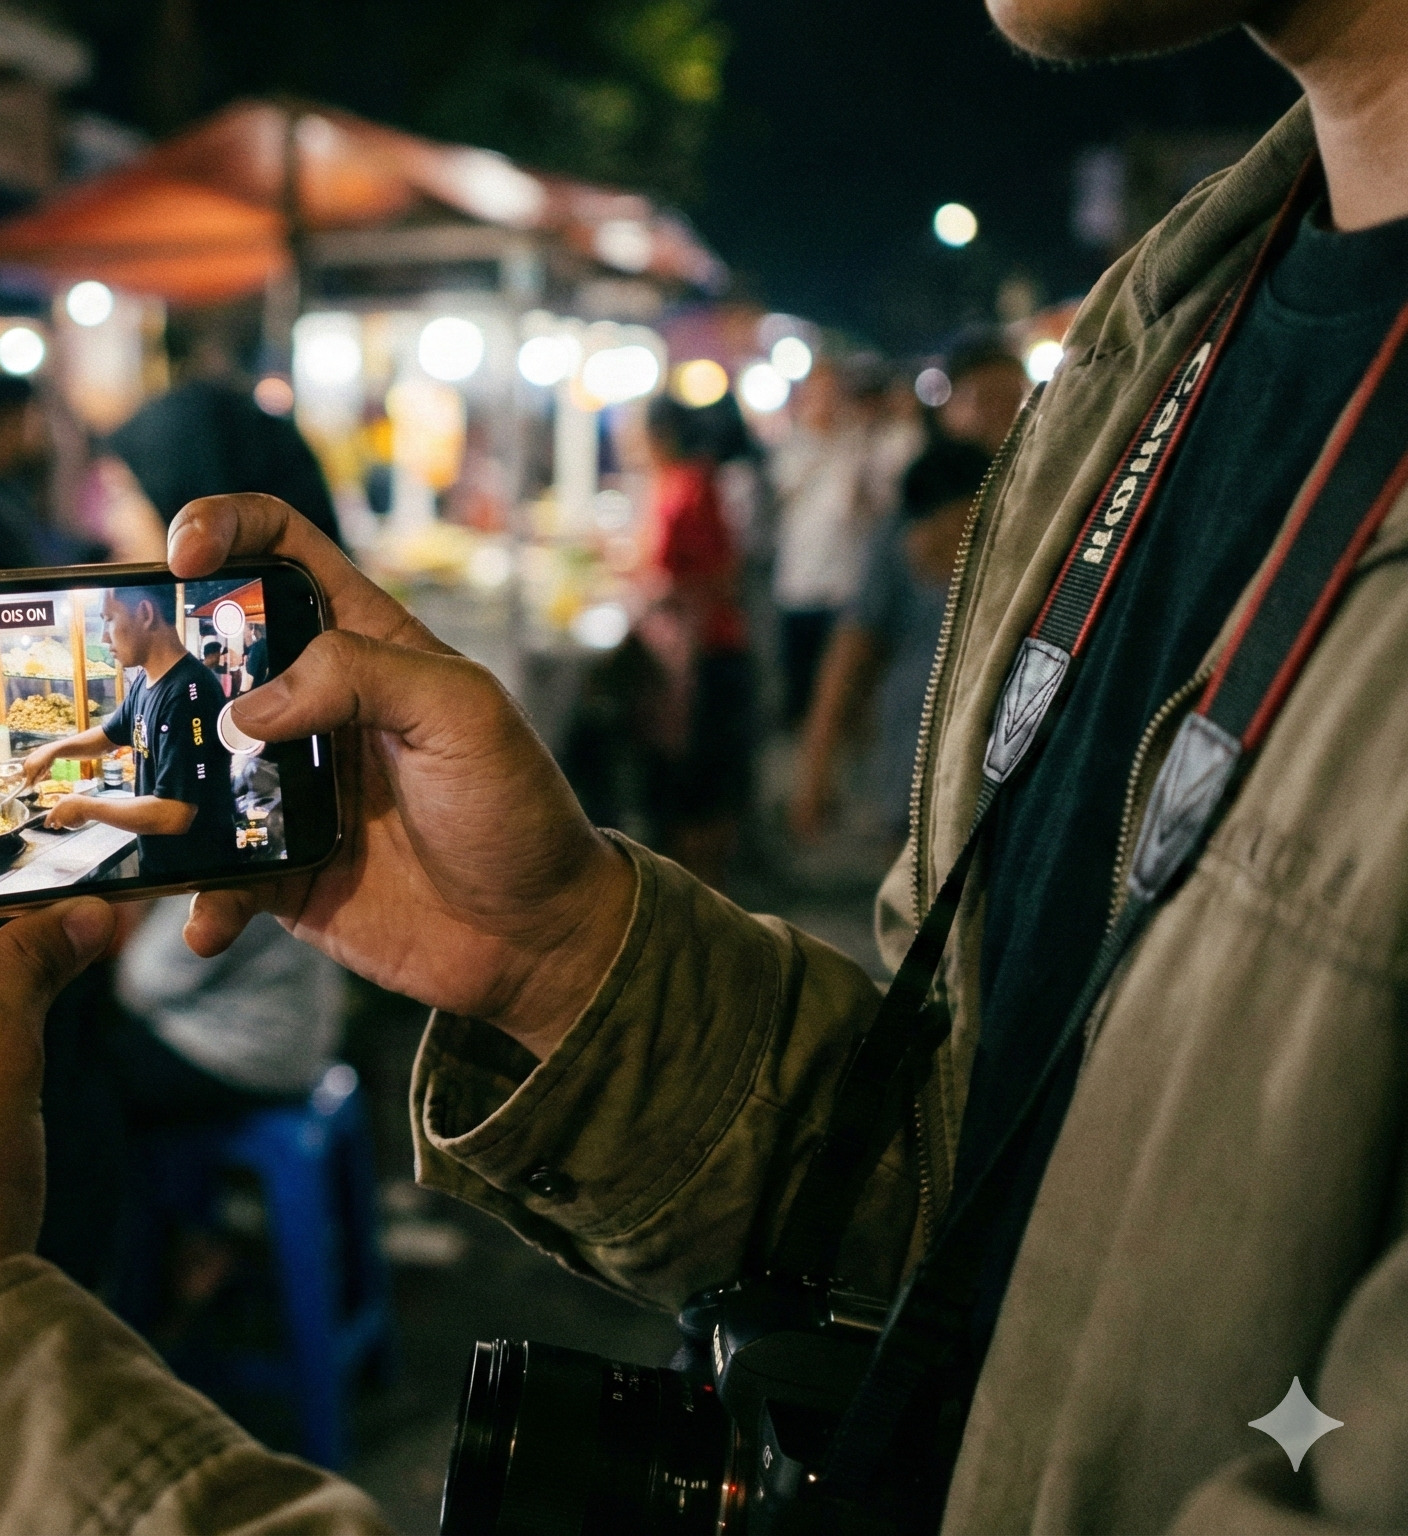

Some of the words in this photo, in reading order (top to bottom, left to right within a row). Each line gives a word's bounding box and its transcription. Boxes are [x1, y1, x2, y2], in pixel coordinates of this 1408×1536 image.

[1083, 342, 1211, 564] Canon
[1, 609, 23, 623] OIS
[26, 608, 46, 621] ON
